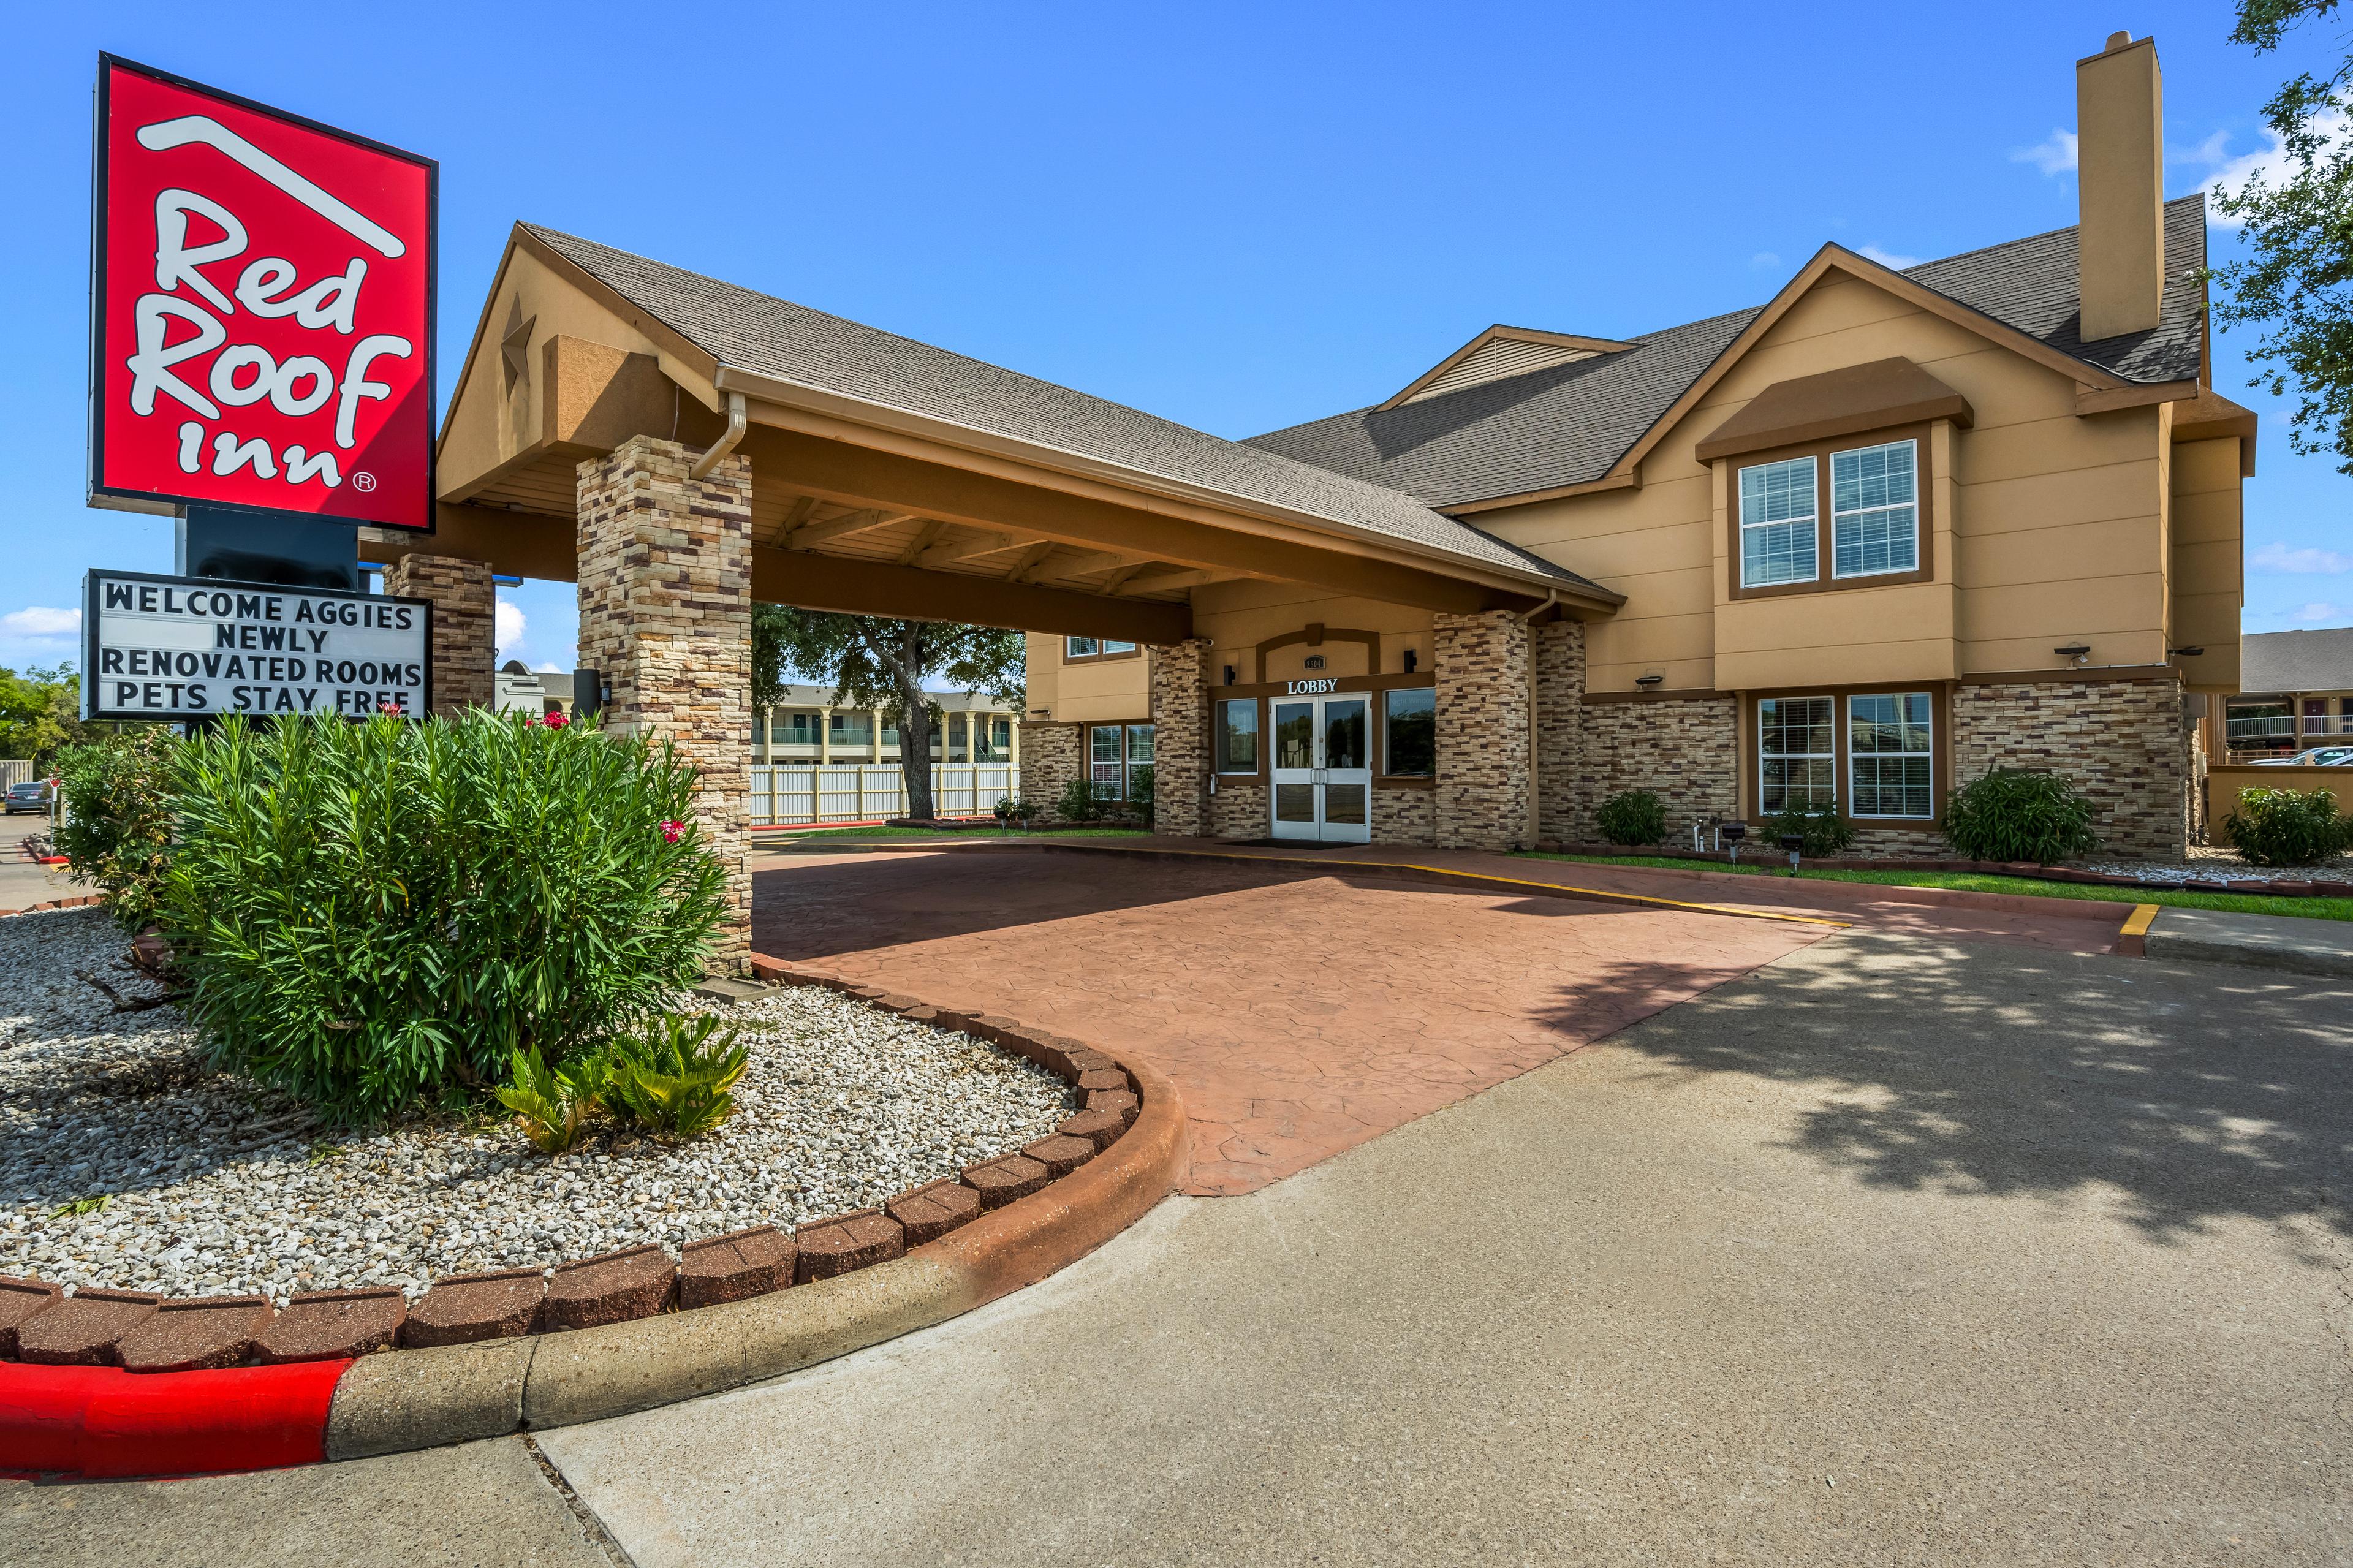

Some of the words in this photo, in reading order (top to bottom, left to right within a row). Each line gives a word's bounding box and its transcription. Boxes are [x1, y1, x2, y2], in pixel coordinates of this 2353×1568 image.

[154, 187, 368, 335] Red
[126, 293, 412, 449] Roof
[177, 421, 343, 488] inn
[105, 583, 282, 621] WELCOME
[295, 599, 412, 630] AGGIES
[216, 624, 328, 653] NEWLY
[102, 648, 306, 682] RENOVATED
[316, 659, 422, 687] ROOMS
[1287, 678, 1338, 695] LOBBY
[116, 681, 207, 710] PETS
[232, 686, 318, 711] STAY
[336, 690, 409, 714] FREE
